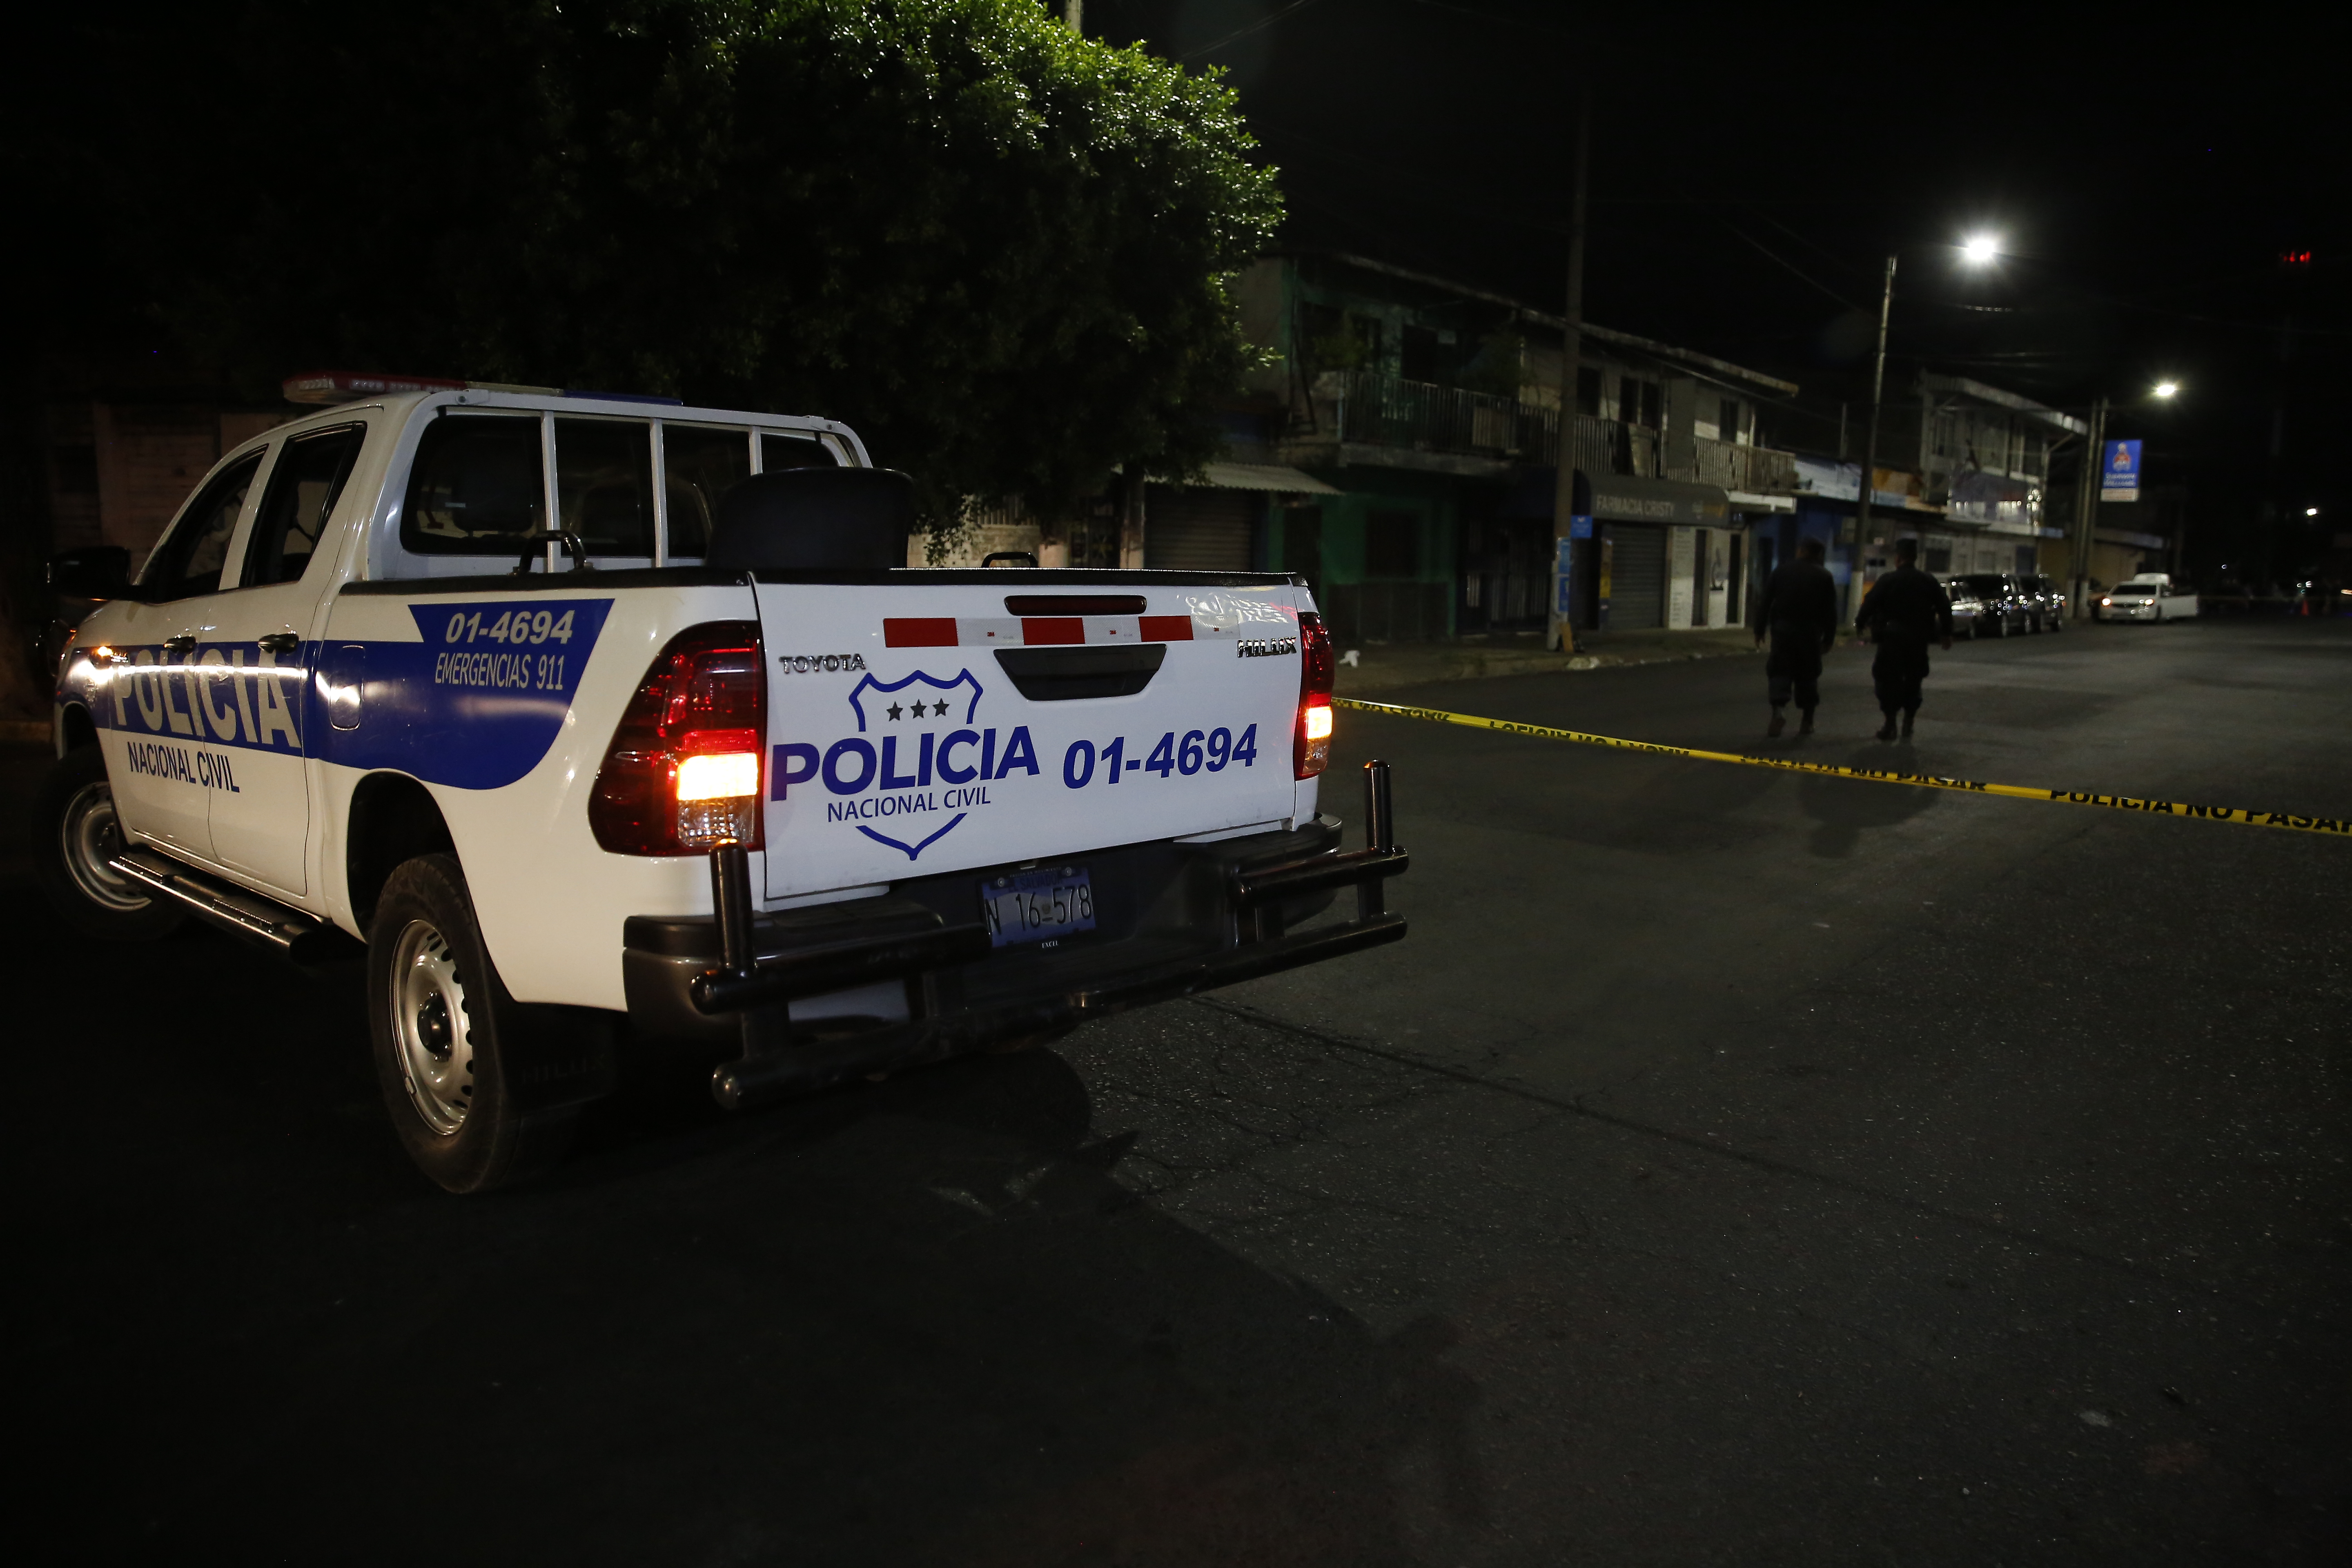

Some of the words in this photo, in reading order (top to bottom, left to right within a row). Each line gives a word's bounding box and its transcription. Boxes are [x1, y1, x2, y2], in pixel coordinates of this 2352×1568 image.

[1596, 494, 1643, 517] FARMACIA
[445, 610, 575, 645] 01-4694
[779, 653, 866, 674] TOYOTA
[1237, 636, 1297, 657] HILUX
[435, 653, 531, 689] EMERGENCIAS
[536, 654, 565, 690] 911
[110, 648, 302, 748] POLICIA
[127, 741, 196, 784] NACIONAL
[197, 751, 240, 793] CIVIL
[771, 726, 1040, 802] POLICIA
[1063, 723, 1257, 789] 01-4694
[827, 792, 938, 822] NACIONAL
[944, 786, 991, 808] CIVIL
[984, 897, 1002, 936] N
[1042, 940, 1059, 949] EXCEL
